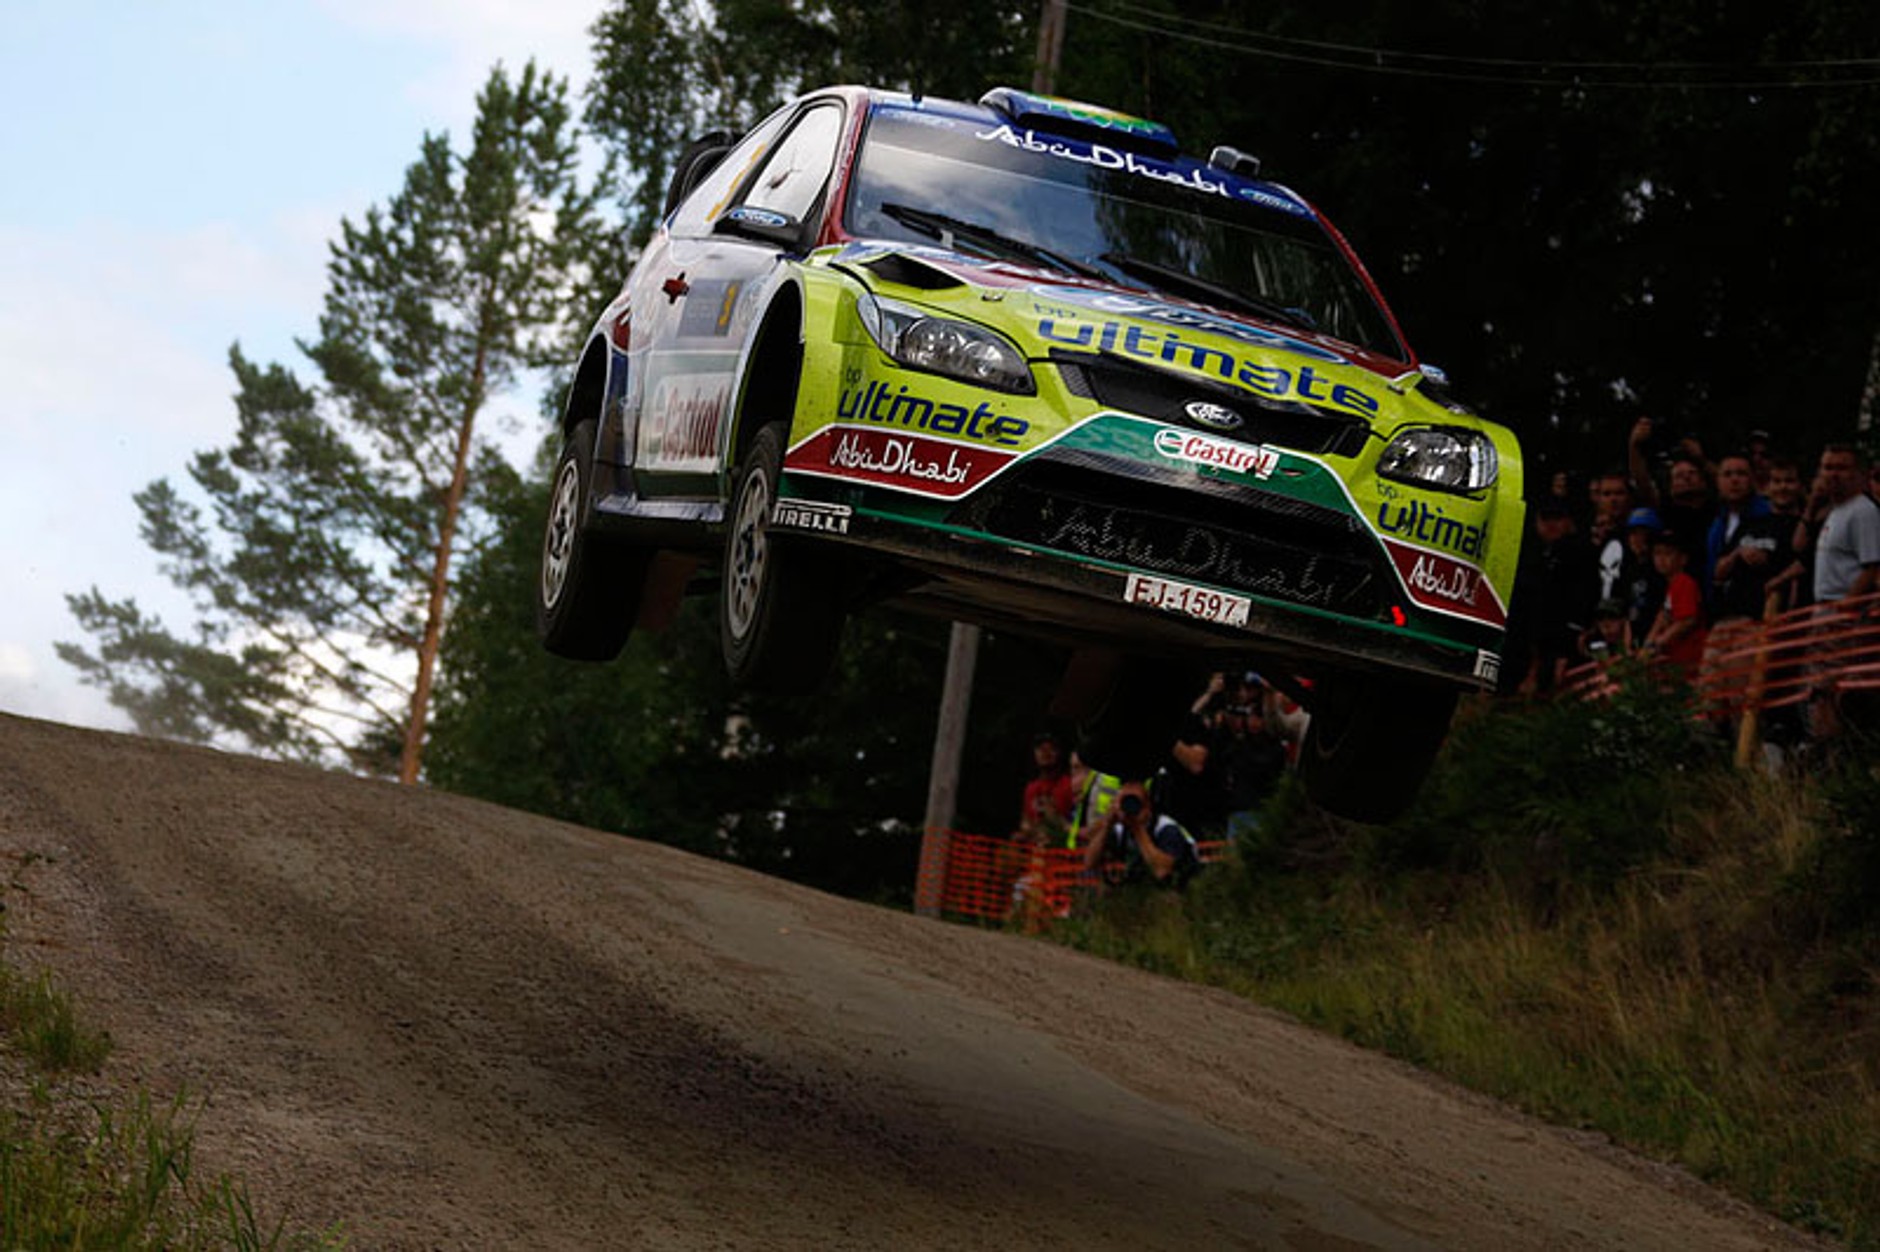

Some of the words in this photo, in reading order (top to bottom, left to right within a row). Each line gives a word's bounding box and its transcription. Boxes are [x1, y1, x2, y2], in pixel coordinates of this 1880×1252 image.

[1038, 319, 1380, 419] ultimate
[837, 380, 1030, 445] ultimate
[1184, 436, 1272, 476] Castrol
